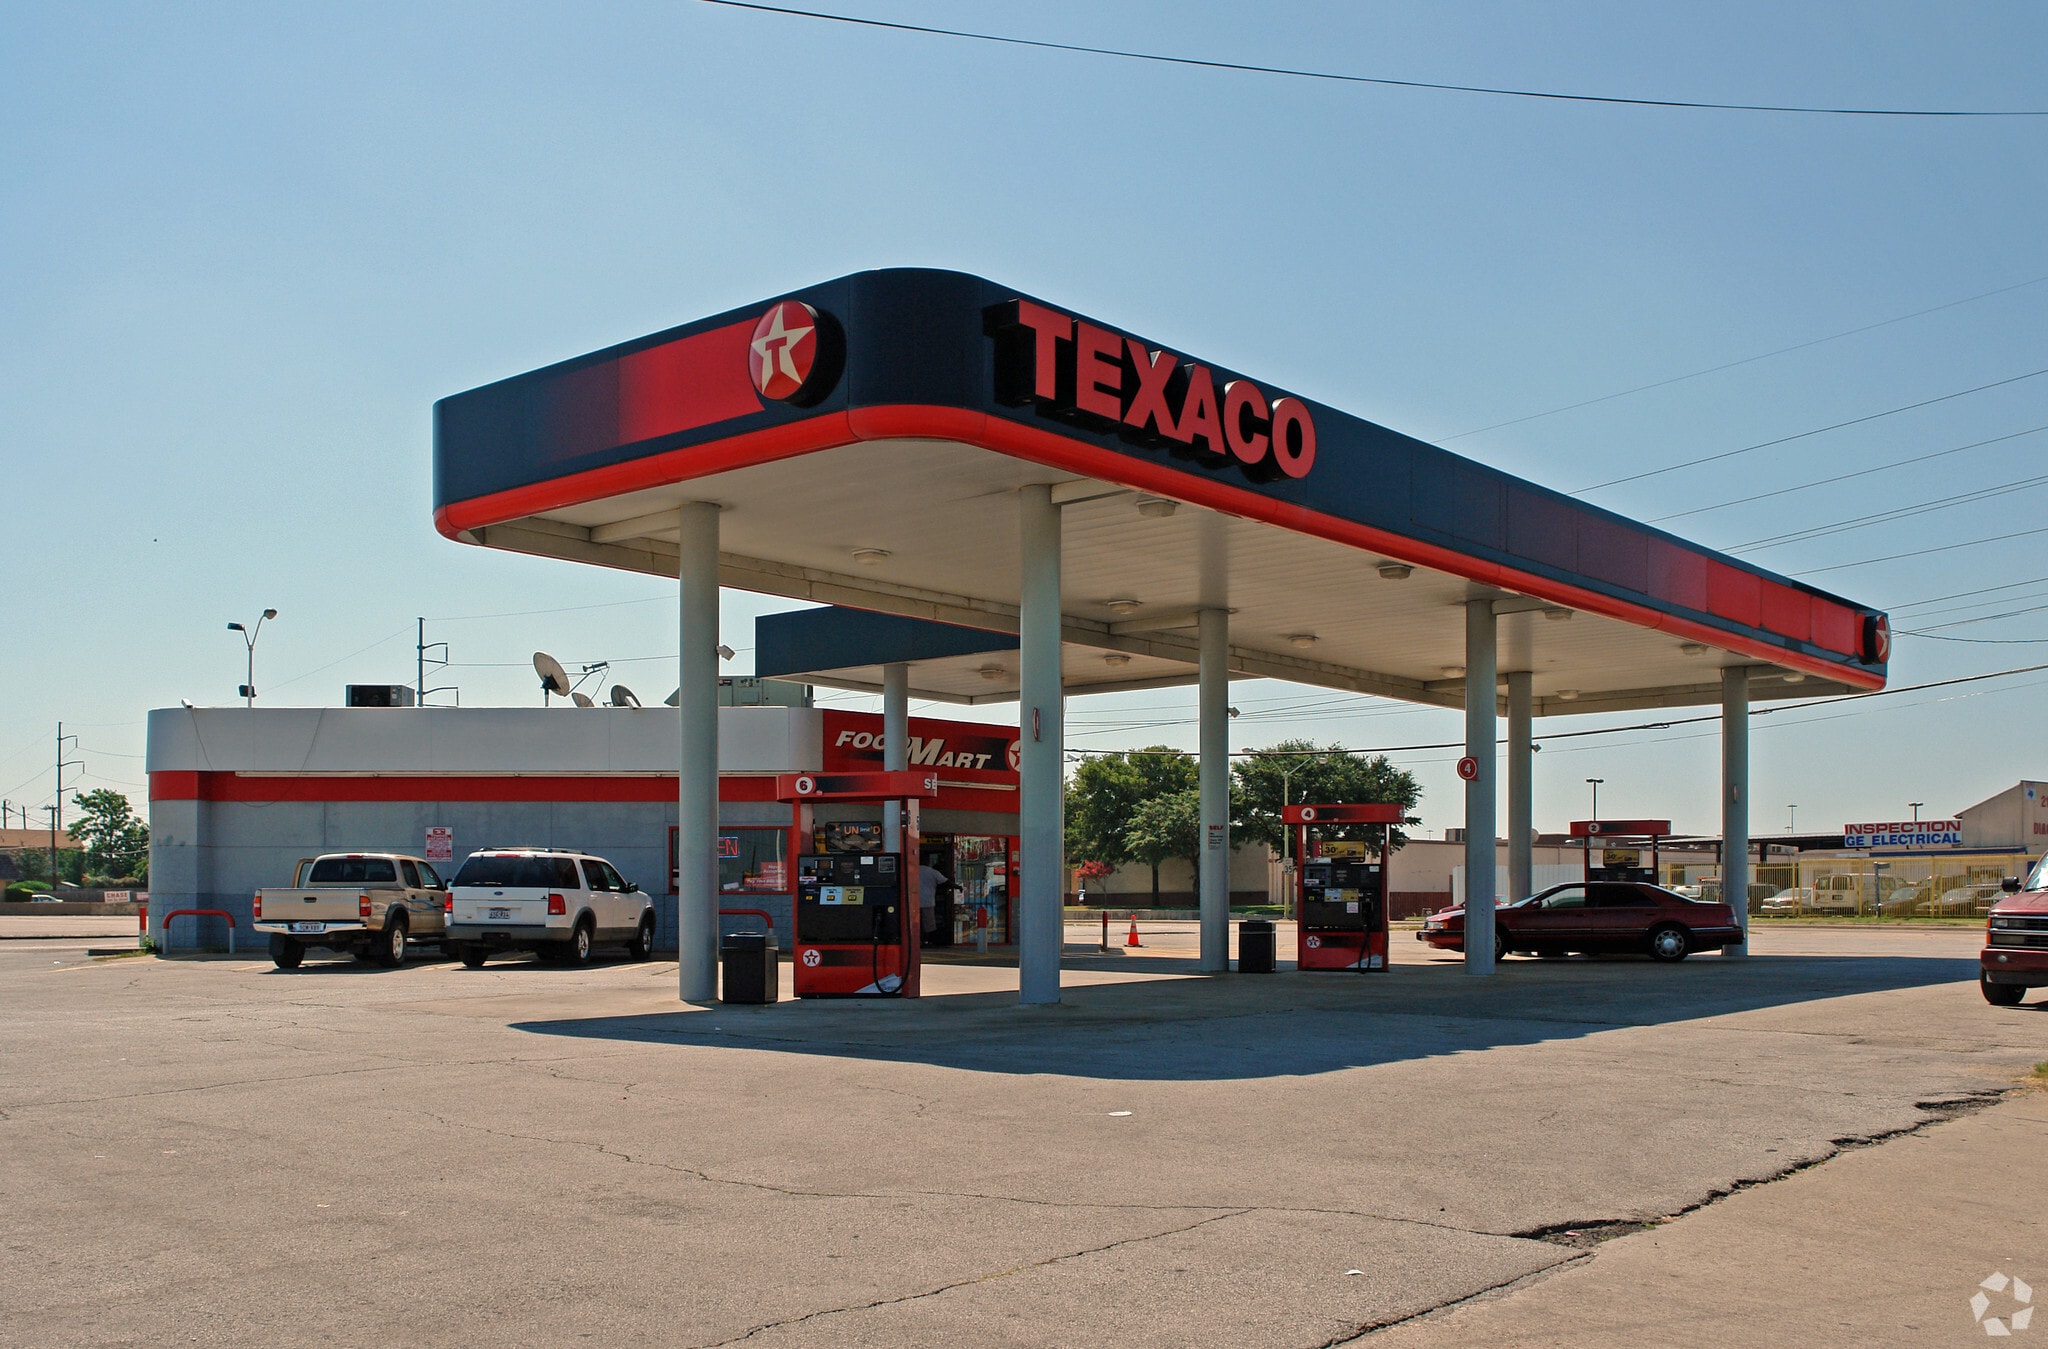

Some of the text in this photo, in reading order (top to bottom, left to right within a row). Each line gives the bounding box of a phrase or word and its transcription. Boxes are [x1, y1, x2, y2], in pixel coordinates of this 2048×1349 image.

[1017, 298, 1317, 480] TEXACO
[1464, 763, 1472, 773] 4
[799, 780, 808, 791] 6
[1844, 820, 1961, 835] INSPECTION
[1846, 829, 1961, 846] GE ELECTRICAL
[1284, 865, 1292, 873] 35
